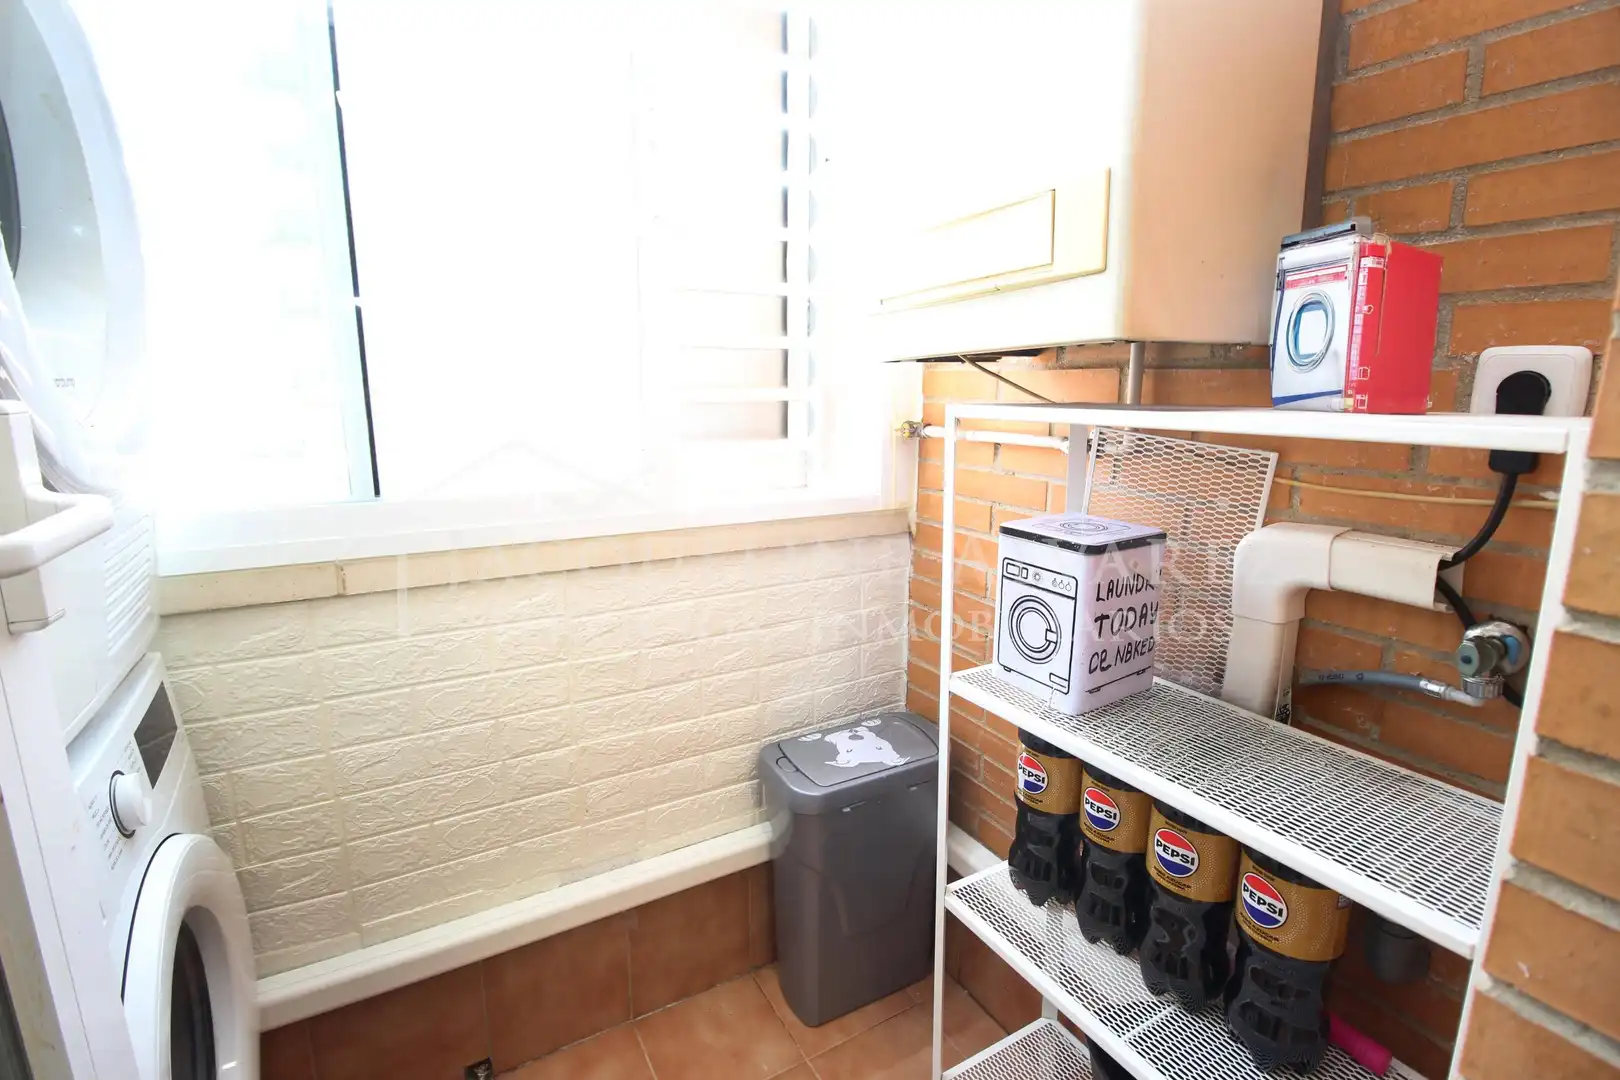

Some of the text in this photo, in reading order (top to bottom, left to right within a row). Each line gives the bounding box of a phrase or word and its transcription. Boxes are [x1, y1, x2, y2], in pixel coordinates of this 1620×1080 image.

[1096, 570, 1161, 602] LAUNDR
[1094, 600, 1159, 639] TODAY
[1114, 636, 1155, 666] NAKED
[1018, 763, 1045, 785] PEPSI
[1085, 797, 1117, 821] PEPSI
[1156, 838, 1195, 866] PEPSI
[1243, 882, 1284, 918] PEPSI
